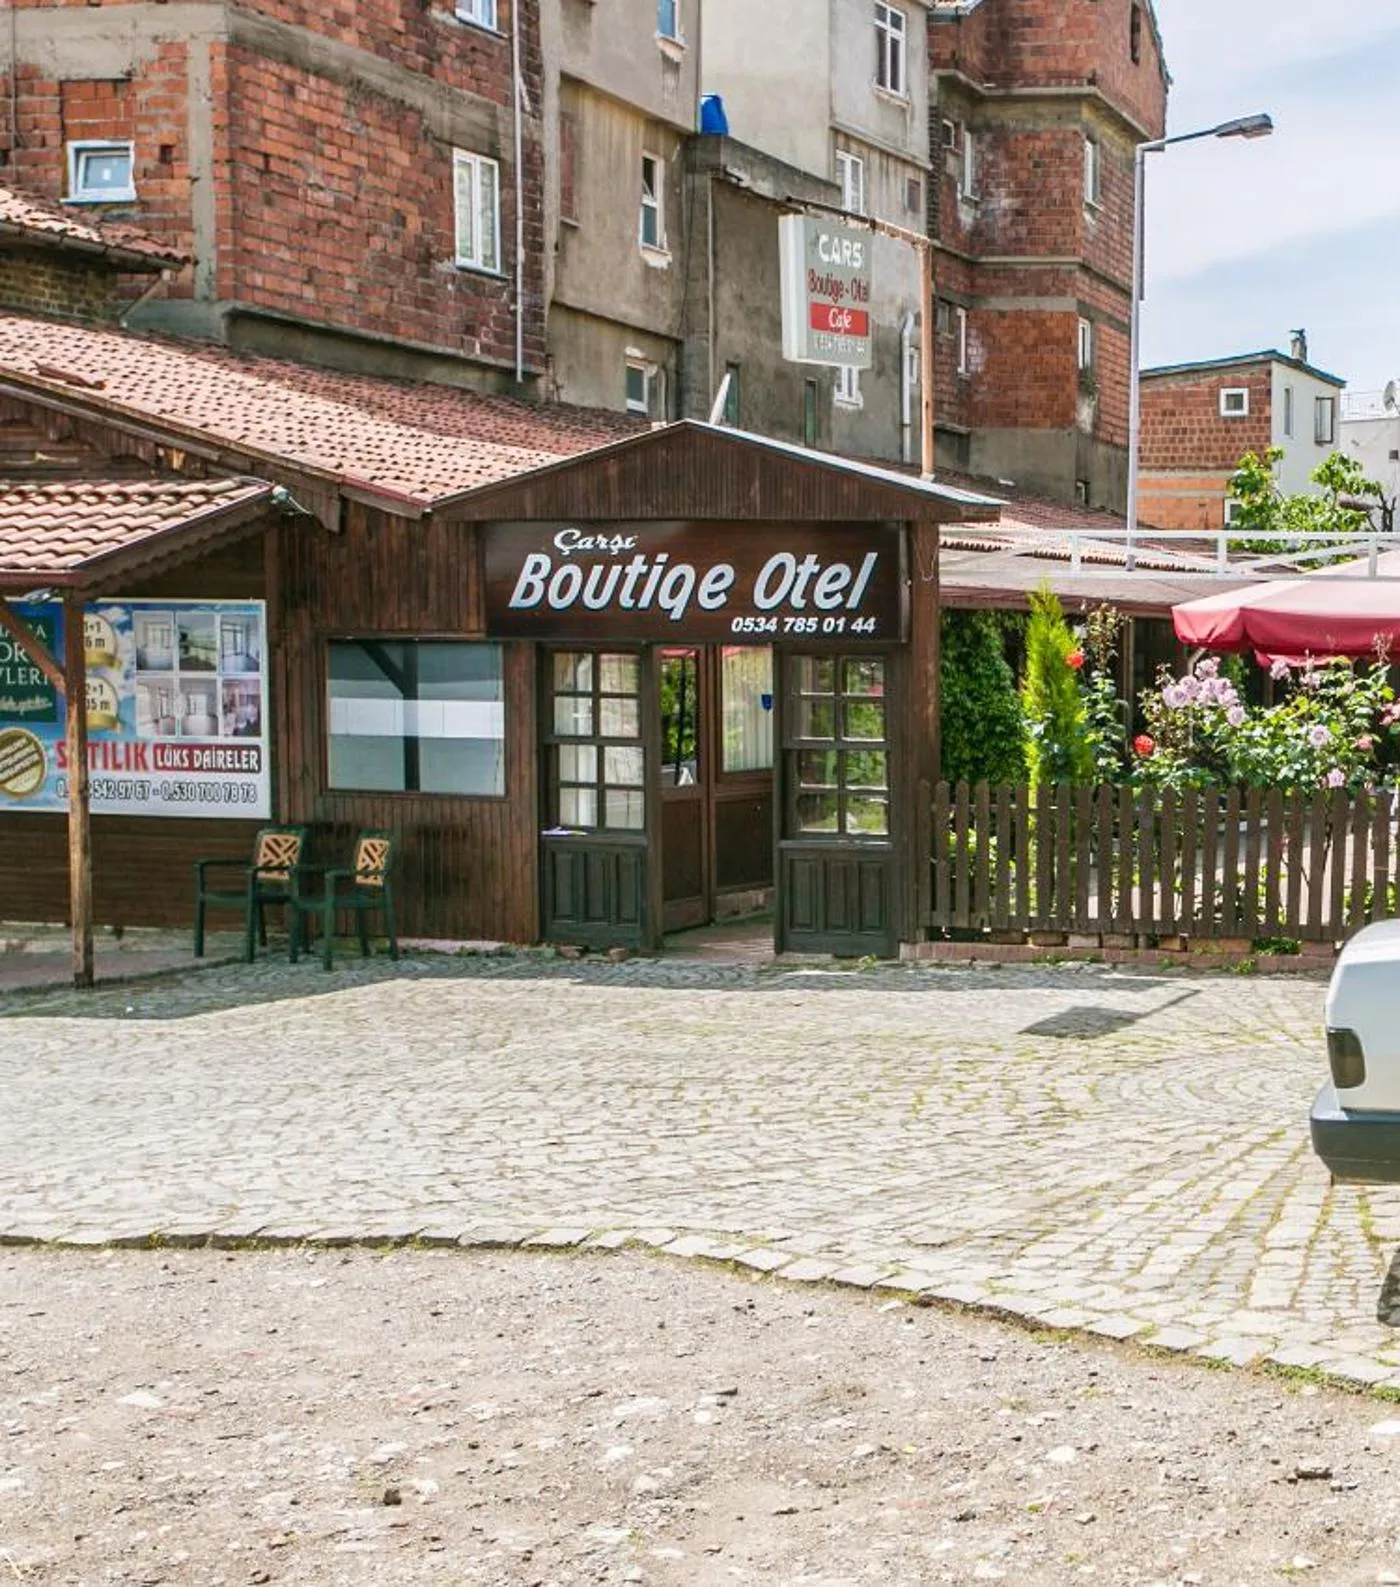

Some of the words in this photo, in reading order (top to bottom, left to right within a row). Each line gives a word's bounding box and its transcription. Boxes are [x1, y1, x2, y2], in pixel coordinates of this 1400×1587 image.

[828, 308, 852, 334] Cafe
[508, 553, 736, 620] Boutiqe
[752, 551, 879, 610] Otel
[731, 617, 777, 633] 0534
[784, 617, 817, 633] 785
[822, 617, 845, 633] 01
[850, 617, 876, 633] 44
[56, 741, 149, 771] STILIK
[156, 745, 189, 768] LÜKS
[193, 748, 259, 770] DAİRELER
